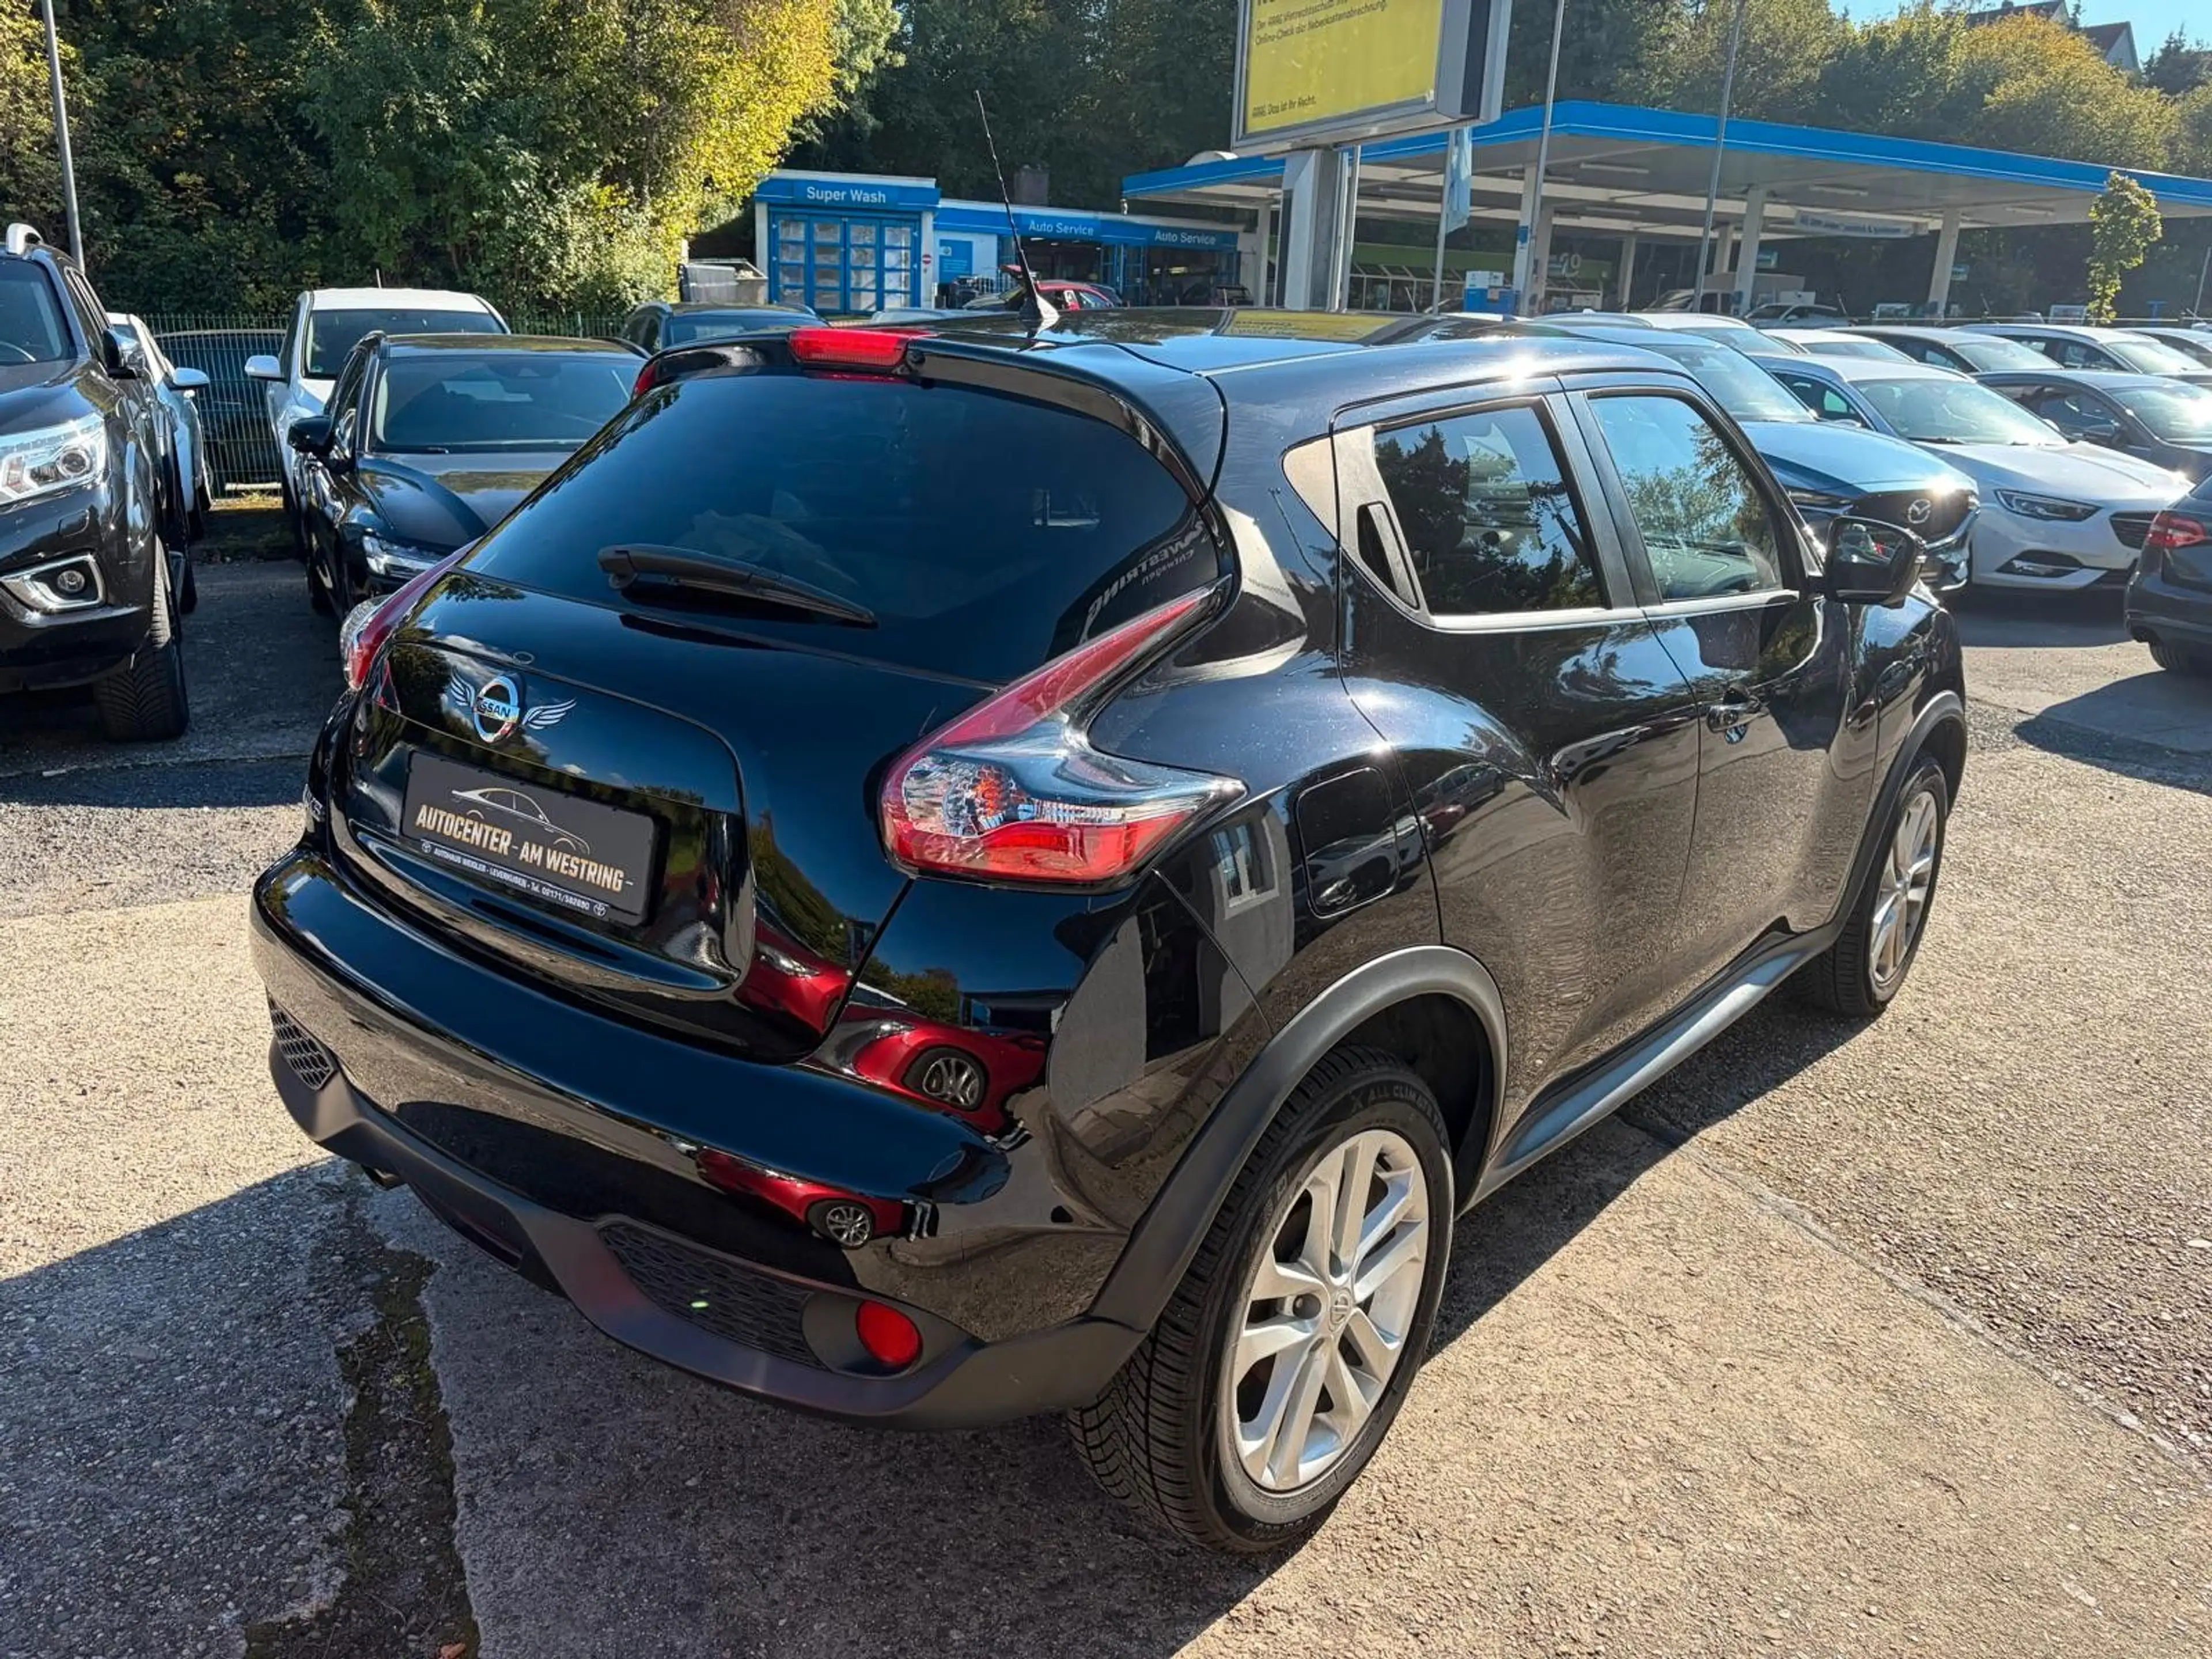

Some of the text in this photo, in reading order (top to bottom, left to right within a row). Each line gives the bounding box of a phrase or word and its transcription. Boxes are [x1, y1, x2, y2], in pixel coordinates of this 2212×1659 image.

[807, 187, 886, 204] Super Wash
[1029, 219, 1094, 236] Auto Service
[1154, 230, 1217, 245] Auto Service
[477, 696, 511, 718] SSAN
[415, 804, 512, 856] AUTOCENTER
[520, 841, 543, 865] AM
[546, 847, 625, 892] WESTRING
